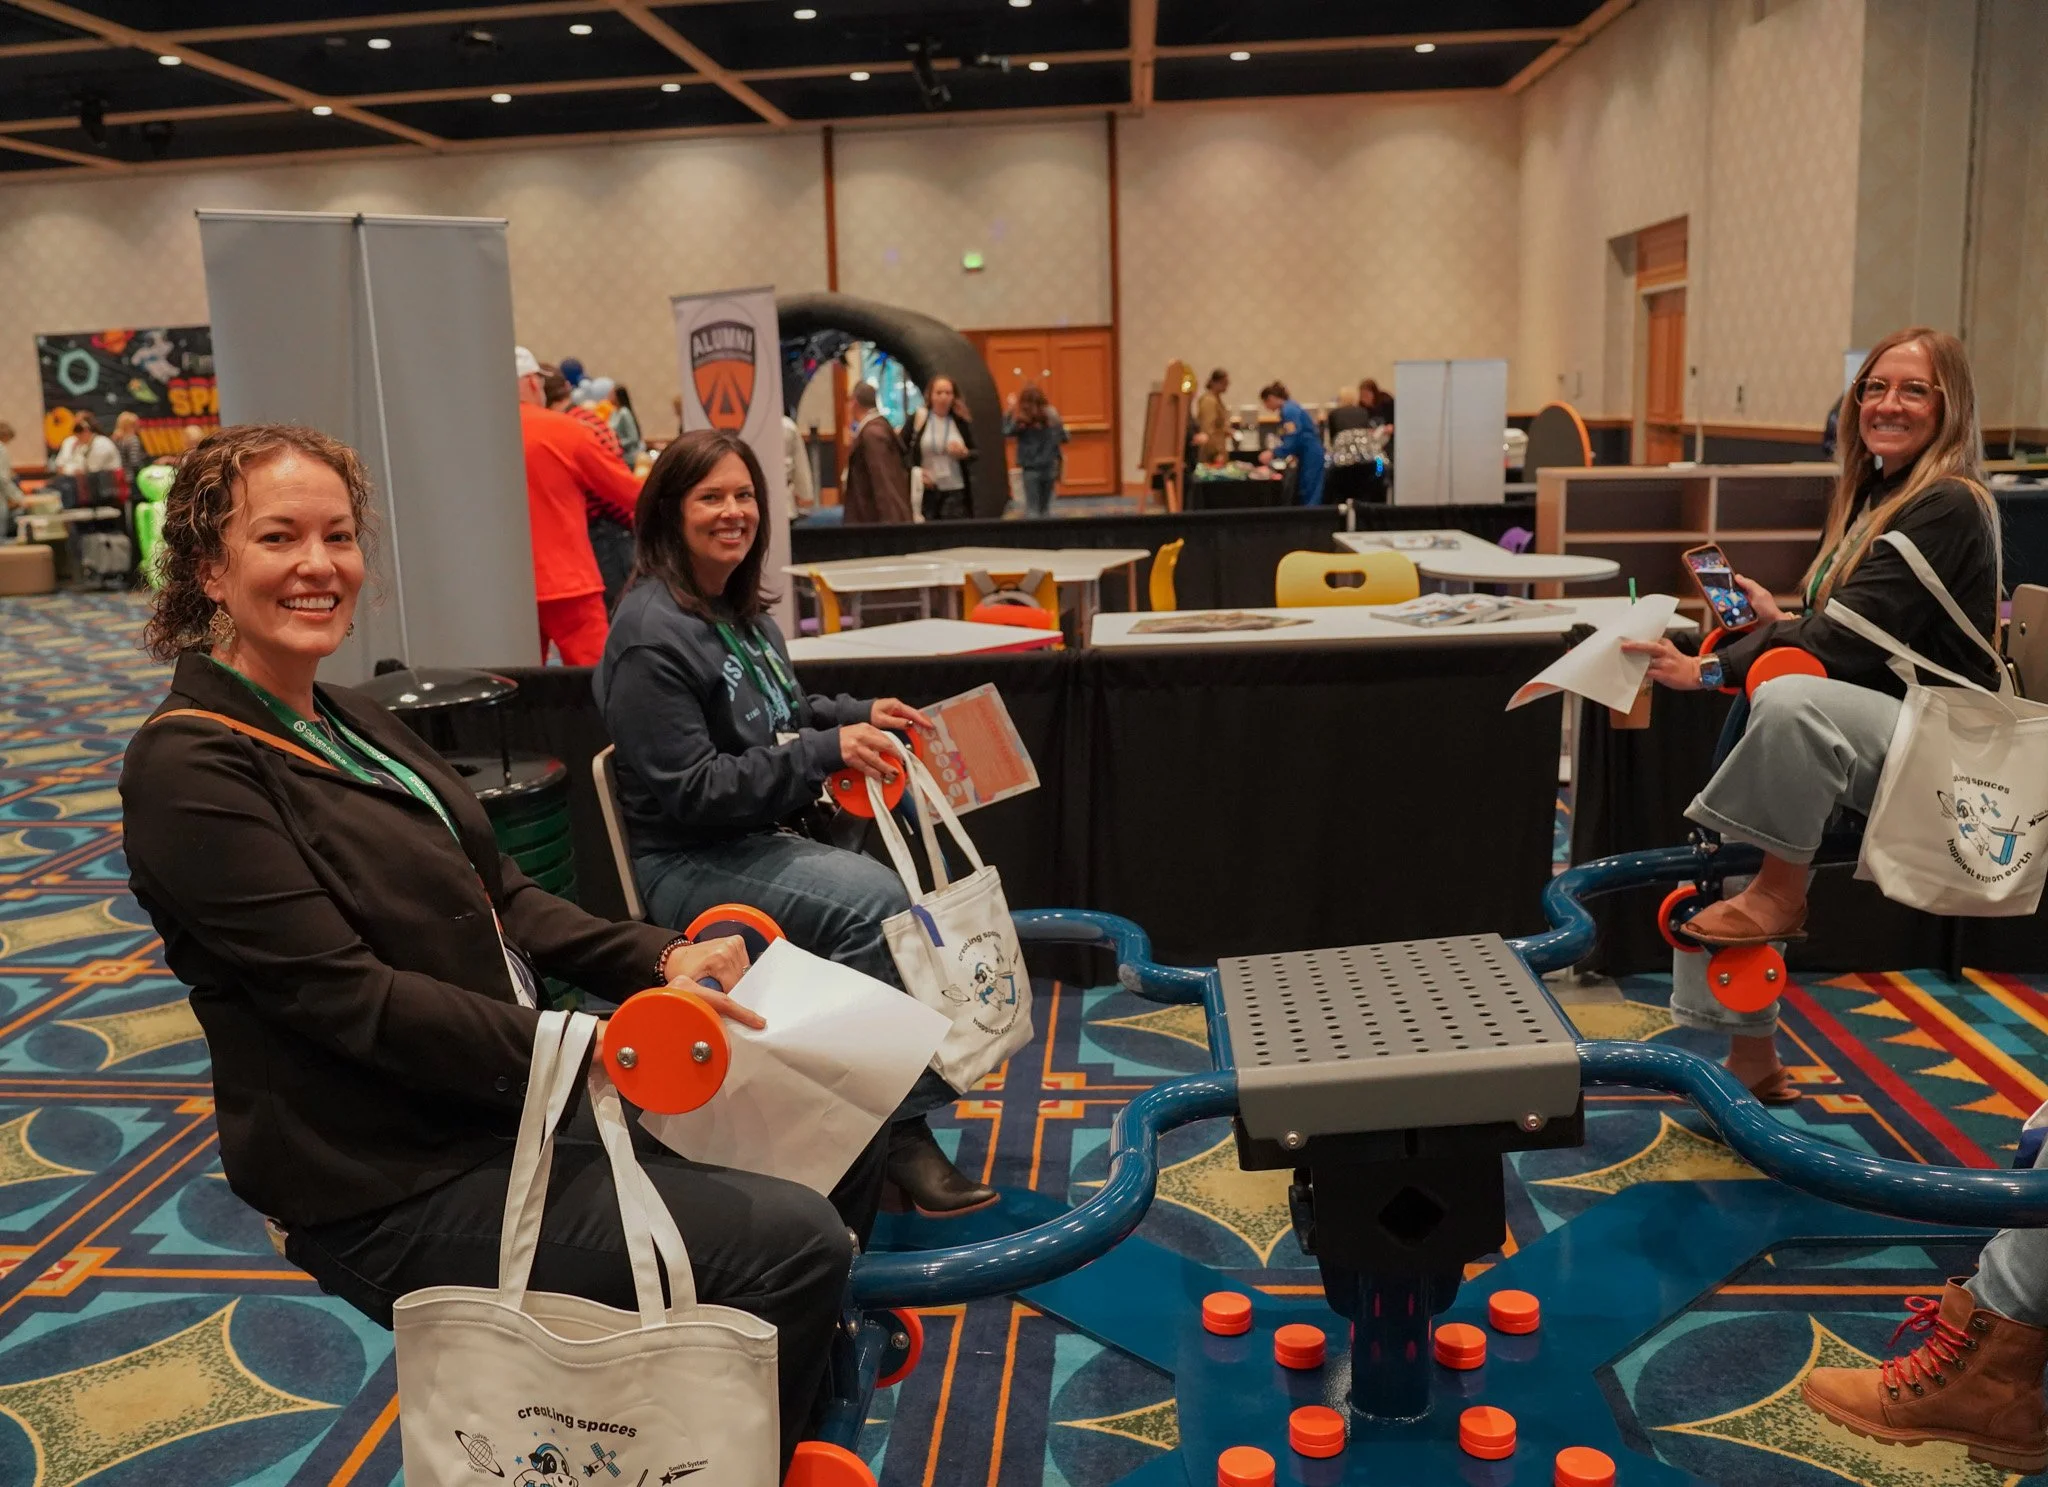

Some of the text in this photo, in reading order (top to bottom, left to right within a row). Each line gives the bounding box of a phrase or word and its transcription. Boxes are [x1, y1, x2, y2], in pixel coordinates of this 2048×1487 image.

[1972, 777, 2010, 795] spaces
[1946, 838, 1975, 878] happiest
[2004, 851, 2033, 877] earth
[958, 934, 983, 962] creating
[517, 1405, 637, 1438] creating spaces
[471, 1433, 490, 1442] culver
[466, 1461, 487, 1475] newlin
[668, 1459, 708, 1473] Smith System
